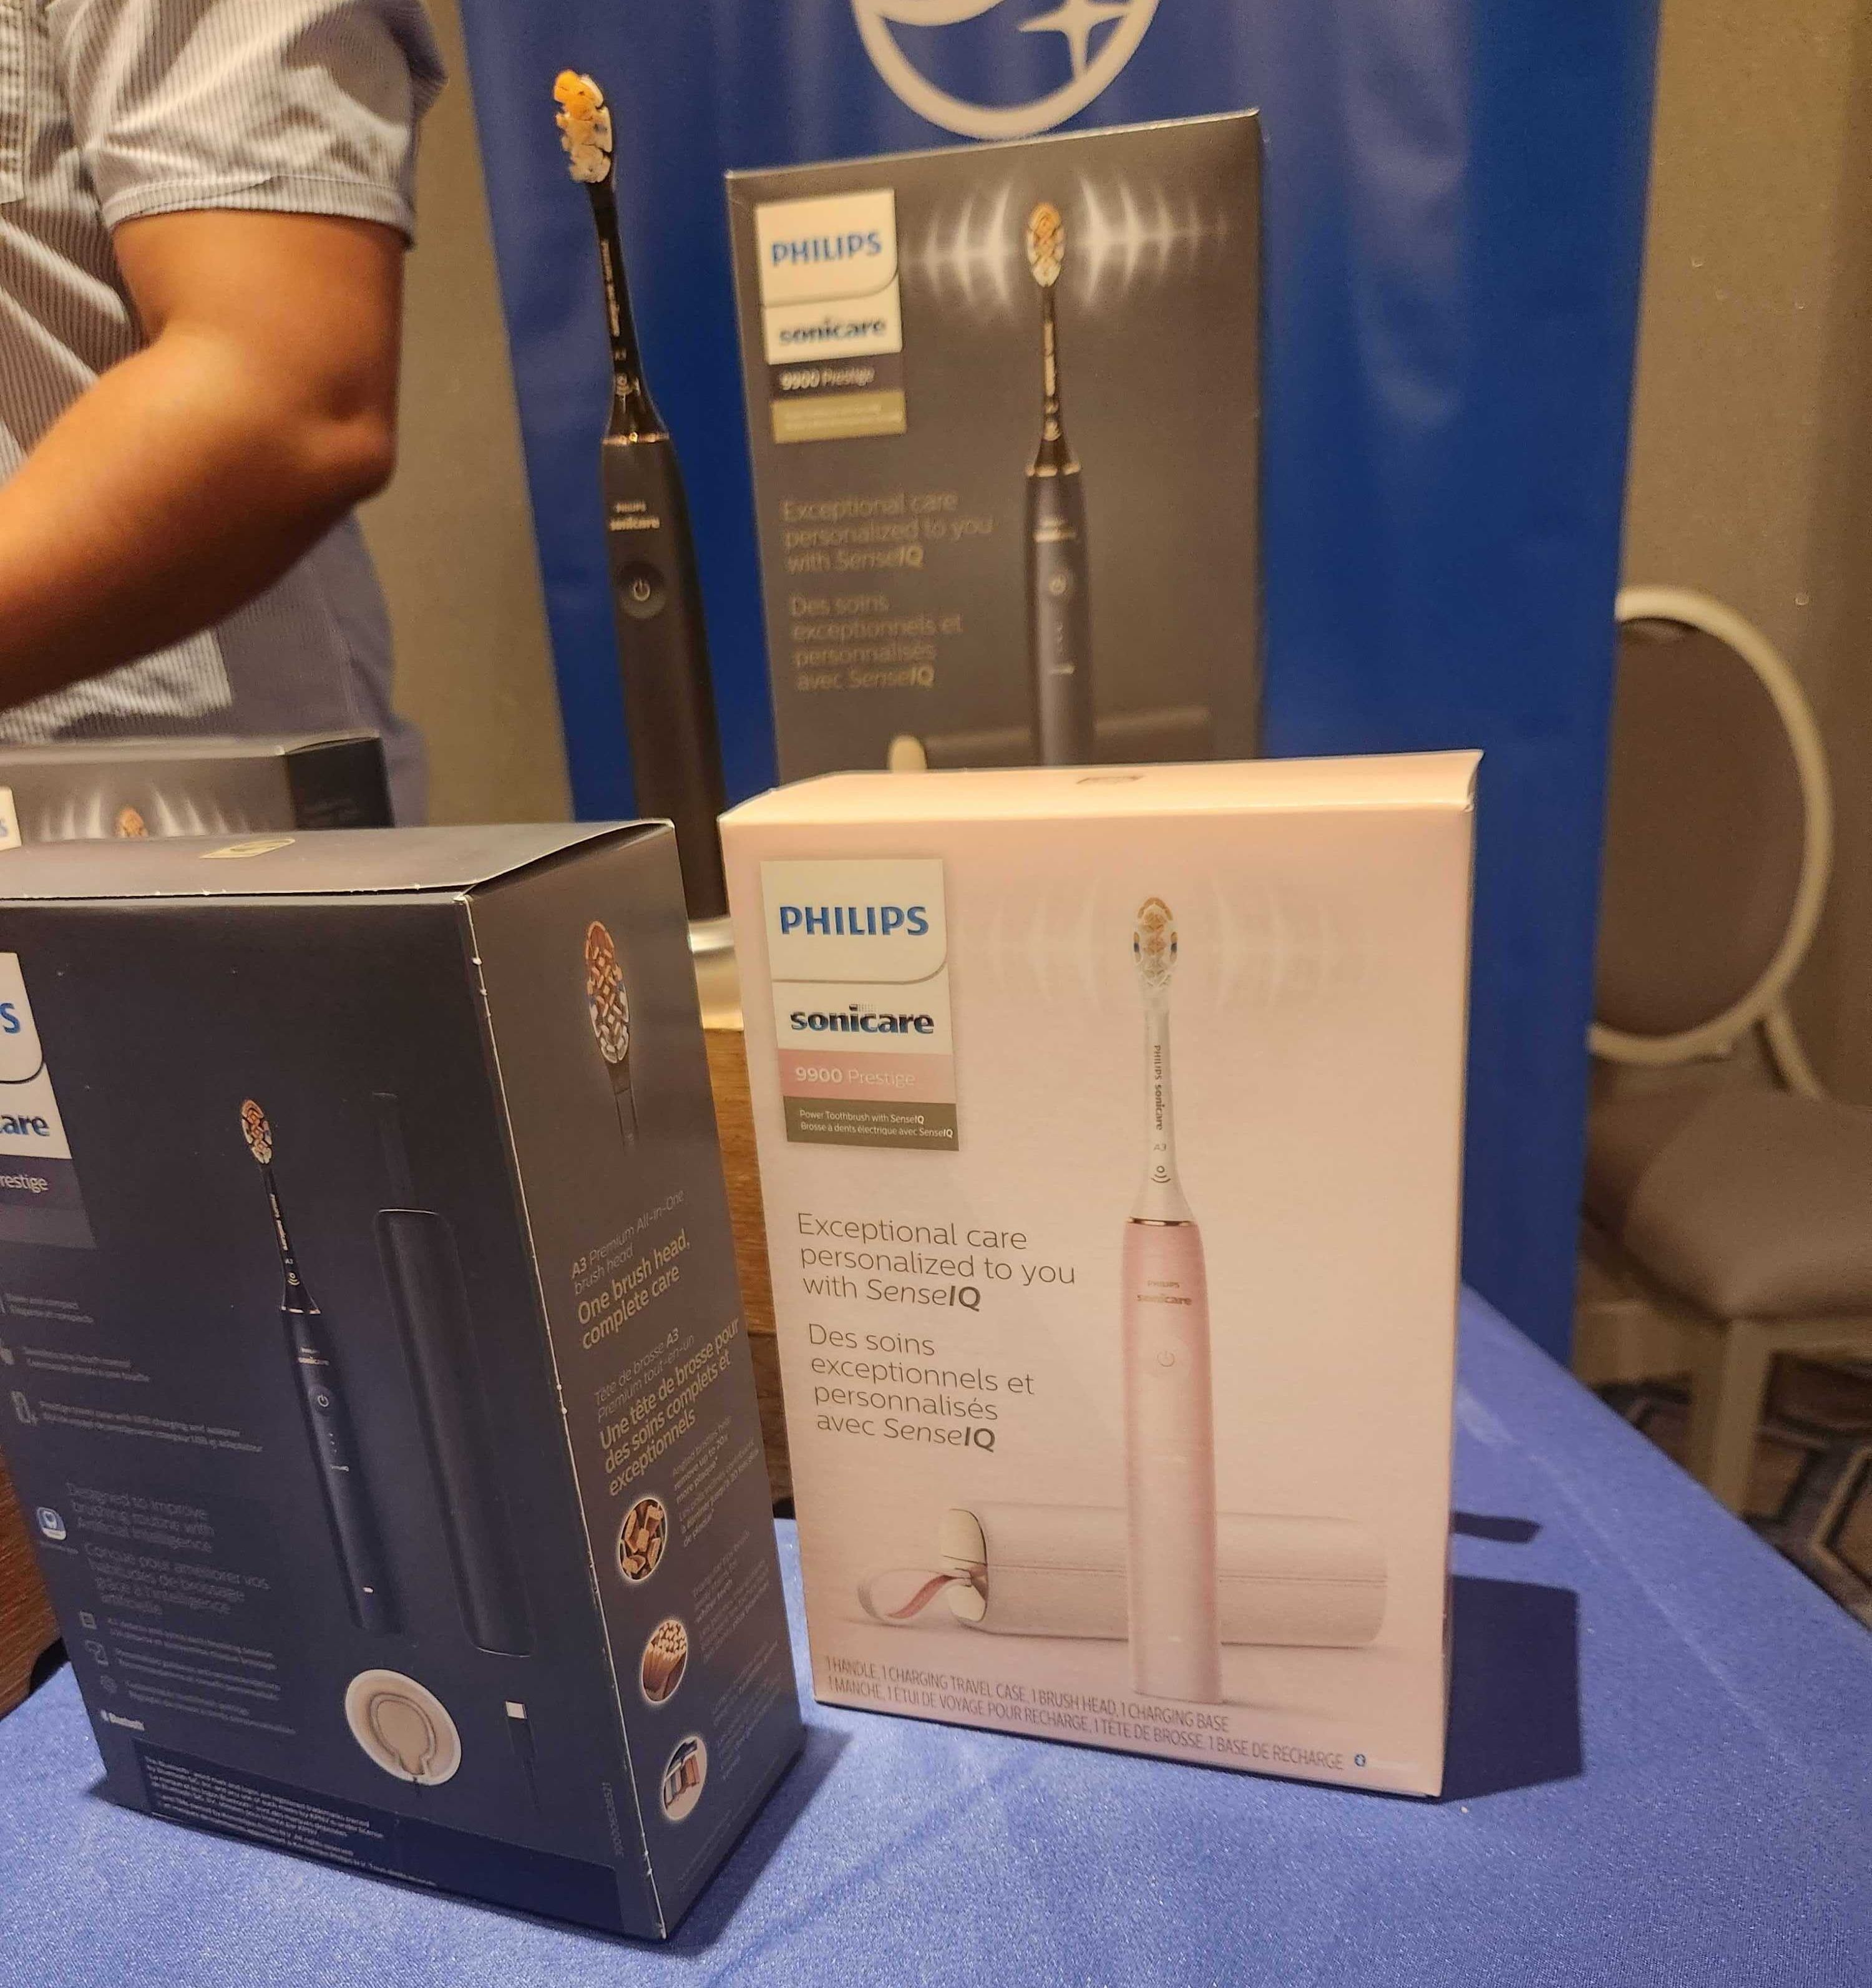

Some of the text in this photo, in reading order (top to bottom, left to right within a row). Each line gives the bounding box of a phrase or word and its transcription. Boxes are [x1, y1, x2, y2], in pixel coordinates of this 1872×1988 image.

[772, 231, 882, 268] PHILIPS
[779, 316, 887, 344] sonicare
[779, 369, 820, 391] 9900
[783, 494, 958, 522] Exceptional care
[784, 515, 993, 549] personalized to you
[787, 549, 831, 573] with
[791, 592, 889, 616] Des soins
[792, 614, 963, 641] exceptionnels et
[797, 669, 844, 691] avec
[779, 905, 930, 937] PHILIPS
[791, 1003, 935, 1035] sonicare
[796, 1066, 915, 1088] 9900 Prestige
[1154, 1044, 1166, 1131] PHILIPS sonicare
[800, 1109, 924, 1125] Power Toothbrush with SenseIQ
[801, 1121, 953, 1139] Brosse à dents électrique avec SenseIQ
[571, 1189, 685, 1280] A3 Premium All-in-One
[798, 1212, 1027, 1250] Exceptional care
[574, 1242, 634, 1295] brush head
[801, 1247, 1075, 1287] personalized to you
[578, 1290, 611, 1325] One
[612, 1256, 653, 1301] brush
[583, 1265, 680, 1350] complete care
[802, 1275, 981, 1312] with SenseIQ
[619, 1368, 631, 1387] de
[634, 1342, 665, 1375] brosse
[666, 1327, 679, 1349] A3
[809, 1323, 935, 1357] Des soins
[598, 1335, 695, 1423] Premium tout-en-un
[600, 1317, 739, 1450] Une tête de brosse pour
[811, 1357, 1035, 1395] exceptionnels et
[605, 1348, 731, 1473] des soins complets et
[814, 1385, 998, 1421] personnalisés
[817, 1413, 996, 1454] avec SenseIQ
[609, 1408, 696, 1497] exceptionnels
[676, 1483, 695, 1505] more
[826, 1655, 831, 1672] 1
[882, 1664, 887, 1680] 1
[889, 1665, 948, 1690] CHARGING
[950, 1674, 993, 1698] TRAVEL
[1031, 1688, 1036, 1703] 1
[1039, 1689, 1079, 1710] BRUSH
[1082, 1695, 1119, 1718] HEAD,
[1121, 1702, 1126, 1718] 1
[1128, 1703, 1194, 1728] CHARGING
[1197, 1713, 1229, 1733] BASE
[829, 1675, 833, 1690] 1
[887, 1685, 892, 1701] 1
[923, 1692, 937, 1708] DE
[939, 1694, 984, 1715] VOYAGE
[988, 1700, 1022, 1721] POUR
[1024, 1707, 1093, 1733] RECHARGE,
[1094, 1717, 1098, 1733] 1
[1134, 1723, 1152, 1741] DE
[1208, 1736, 1214, 1750] 1
[1217, 1737, 1249, 1757] BASE
[1252, 1742, 1270, 1760] DE
[1273, 1743, 1343, 1771] RECHARGE
